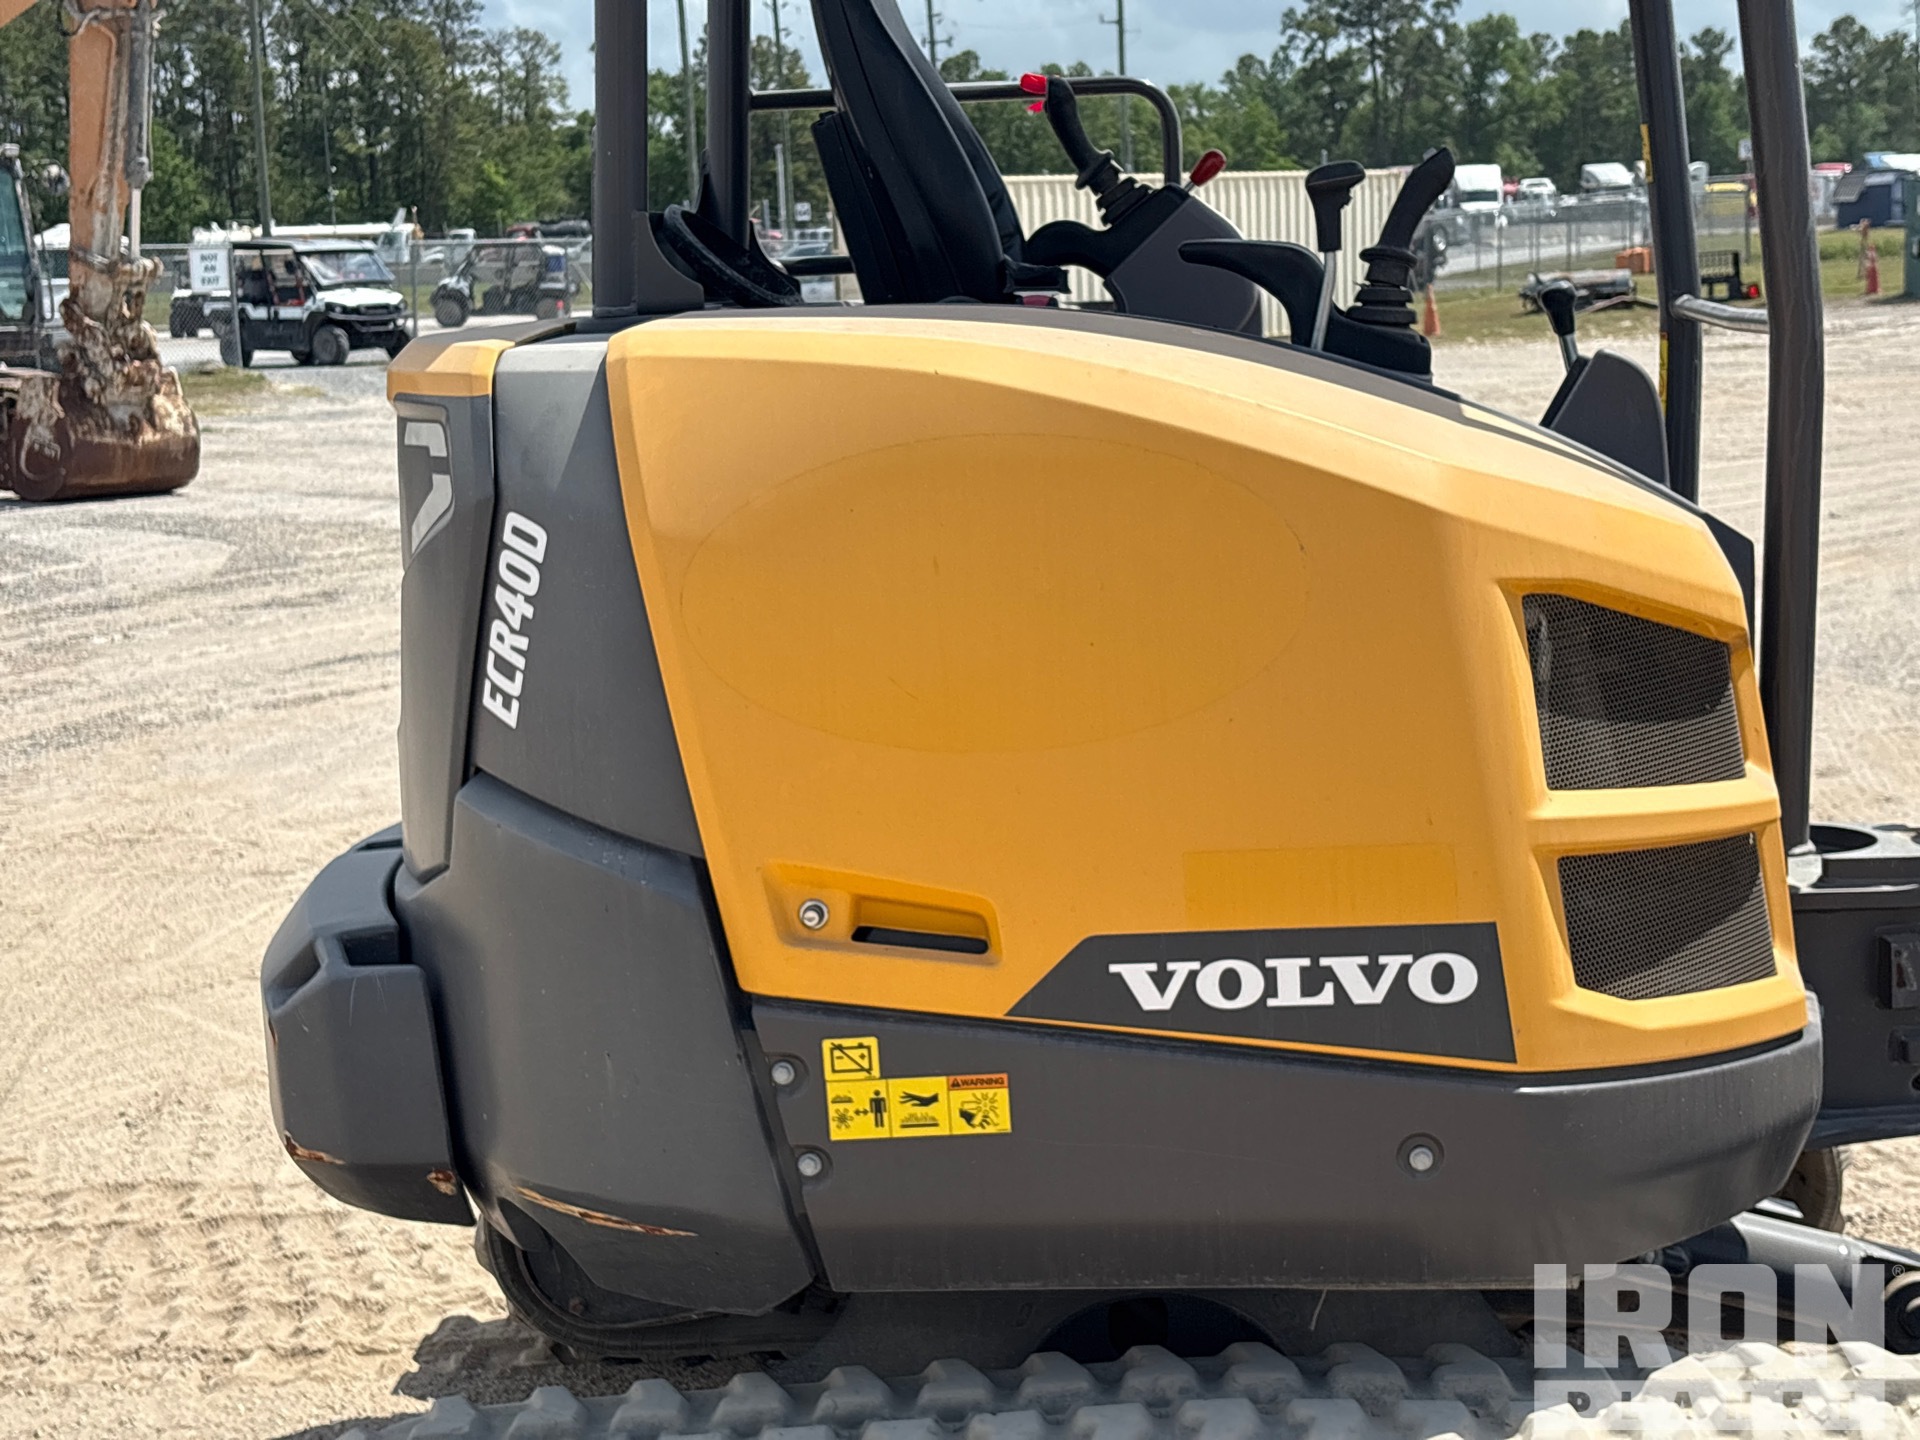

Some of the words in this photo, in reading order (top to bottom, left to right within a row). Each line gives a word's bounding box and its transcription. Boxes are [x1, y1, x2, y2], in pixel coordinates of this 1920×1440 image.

[200, 252, 218, 262] NOT
[204, 264, 217, 273] AN
[201, 275, 220, 286] EXIT
[482, 511, 548, 730] ECR40D
[1108, 952, 1479, 1012] VOLVO
[960, 1077, 1005, 1087] WARNING
